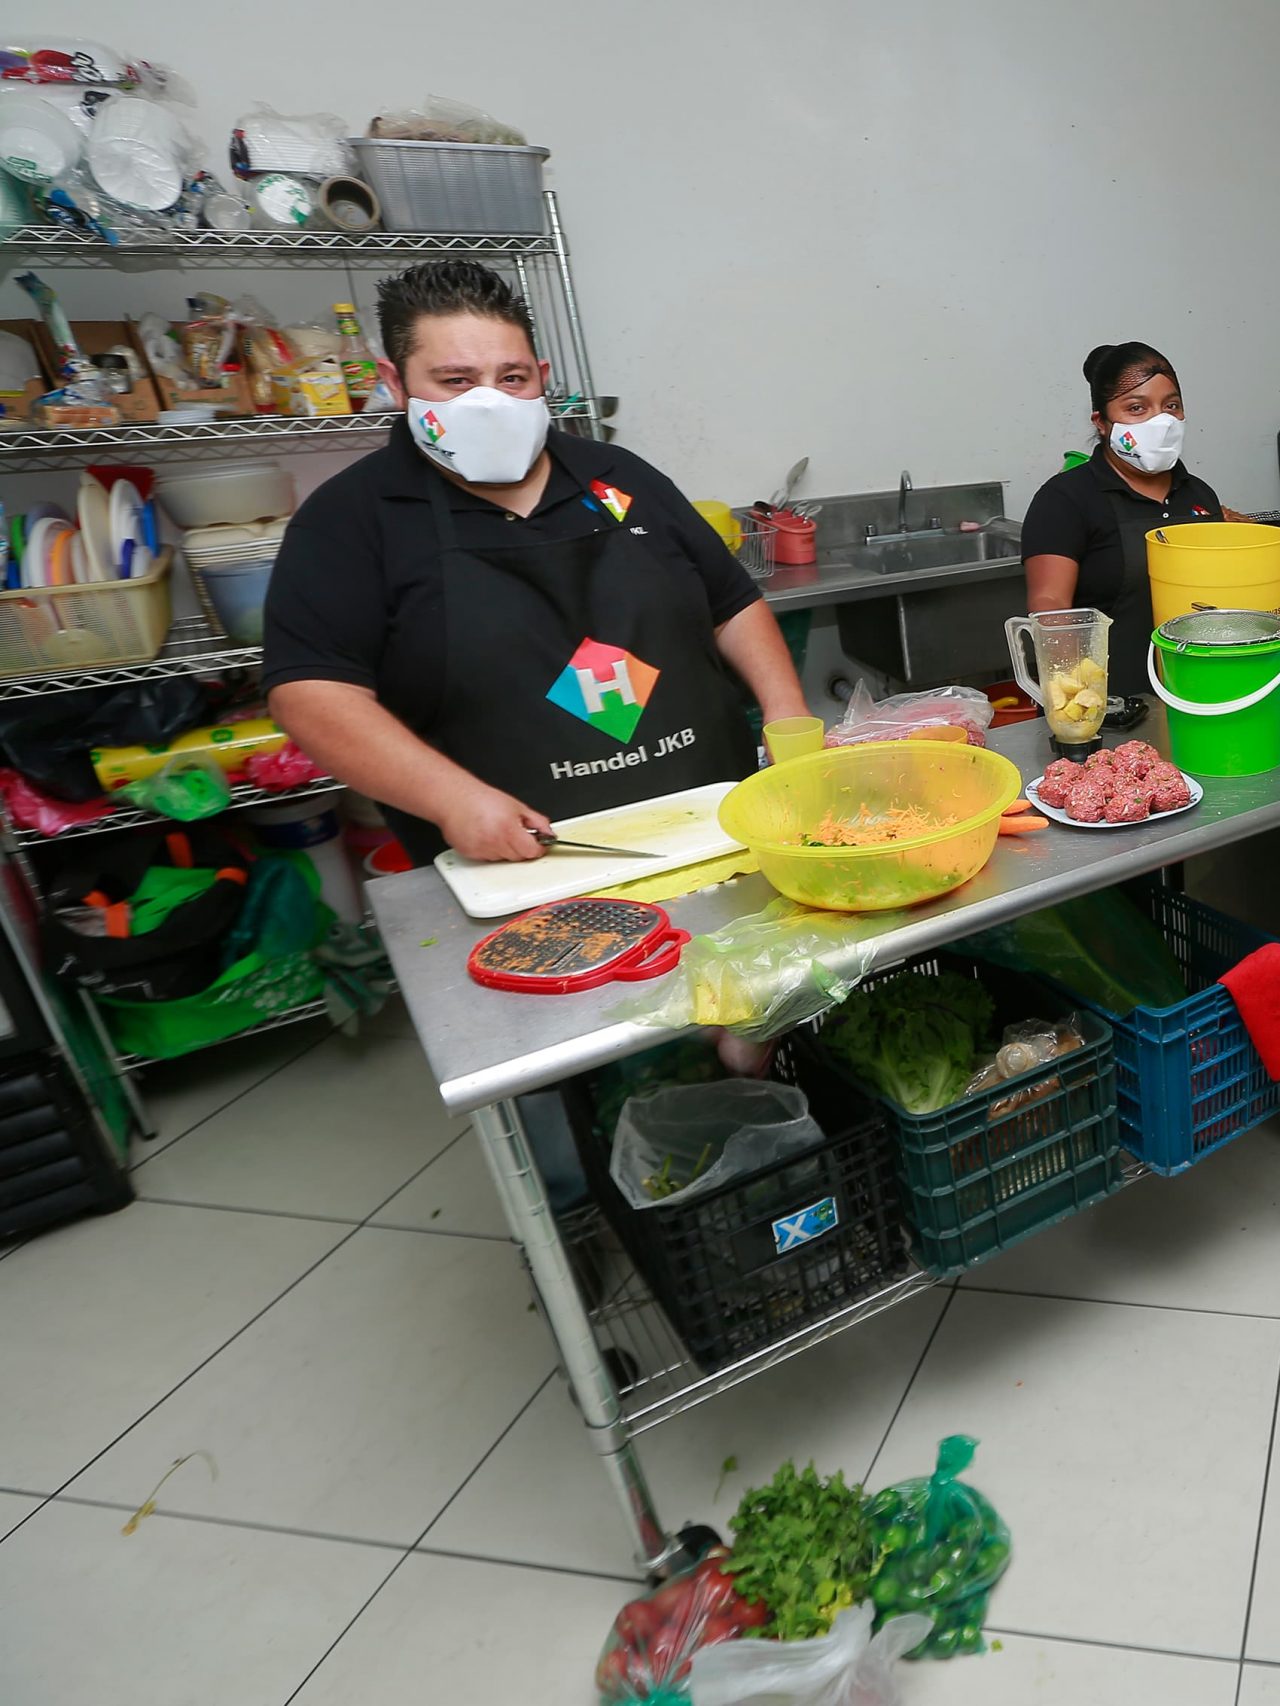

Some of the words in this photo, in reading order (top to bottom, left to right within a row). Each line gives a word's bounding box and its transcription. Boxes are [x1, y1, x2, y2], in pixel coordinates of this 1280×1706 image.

[576, 659, 637, 714] H
[550, 745, 649, 781] Handel
[654, 728, 697, 758] JKB
